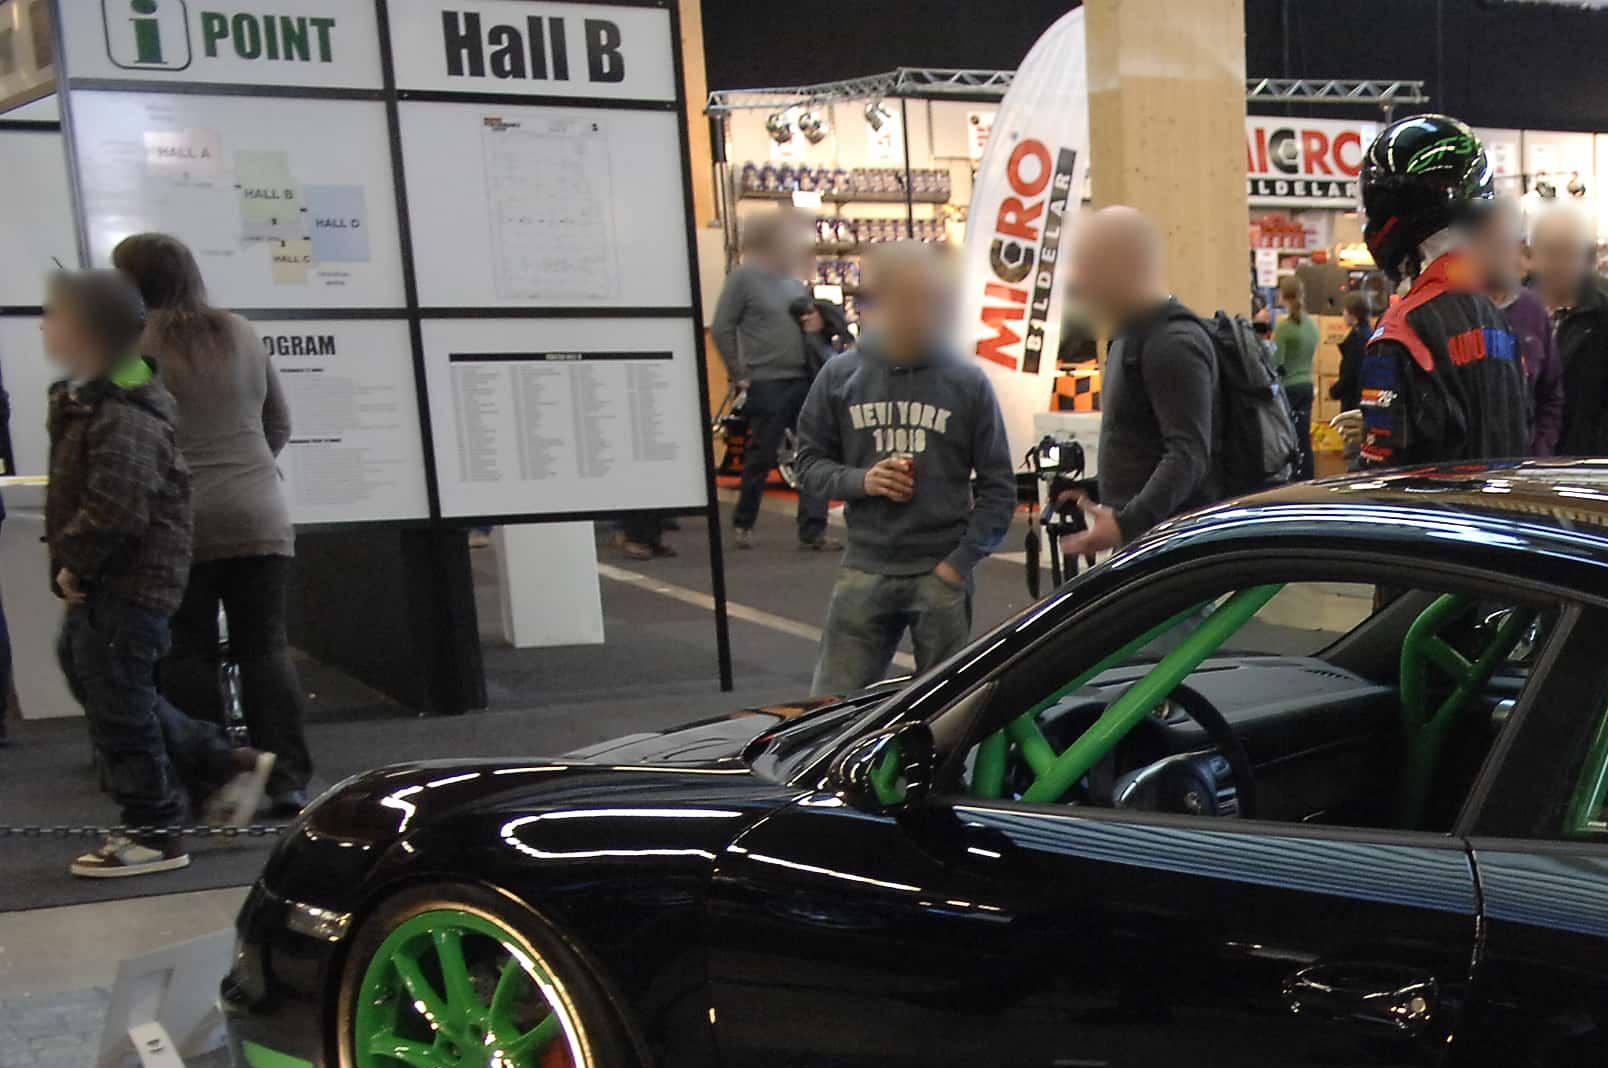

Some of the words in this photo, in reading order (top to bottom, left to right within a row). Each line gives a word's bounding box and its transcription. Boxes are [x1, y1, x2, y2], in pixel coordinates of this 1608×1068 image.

[200, 11, 336, 63] POINT
[441, 10, 569, 81] Hall
[584, 18, 625, 83] B
[157, 147, 200, 158] HALL
[1247, 127, 1362, 178] ICRO
[244, 188, 280, 200] HALL
[315, 218, 347, 228] HALL
[273, 255, 300, 263] HALL
[976, 138, 1052, 371] MICRO
[1027, 171, 1072, 352] BILDELAR
[849, 401, 894, 429] NEW
[896, 401, 952, 434] YORK
